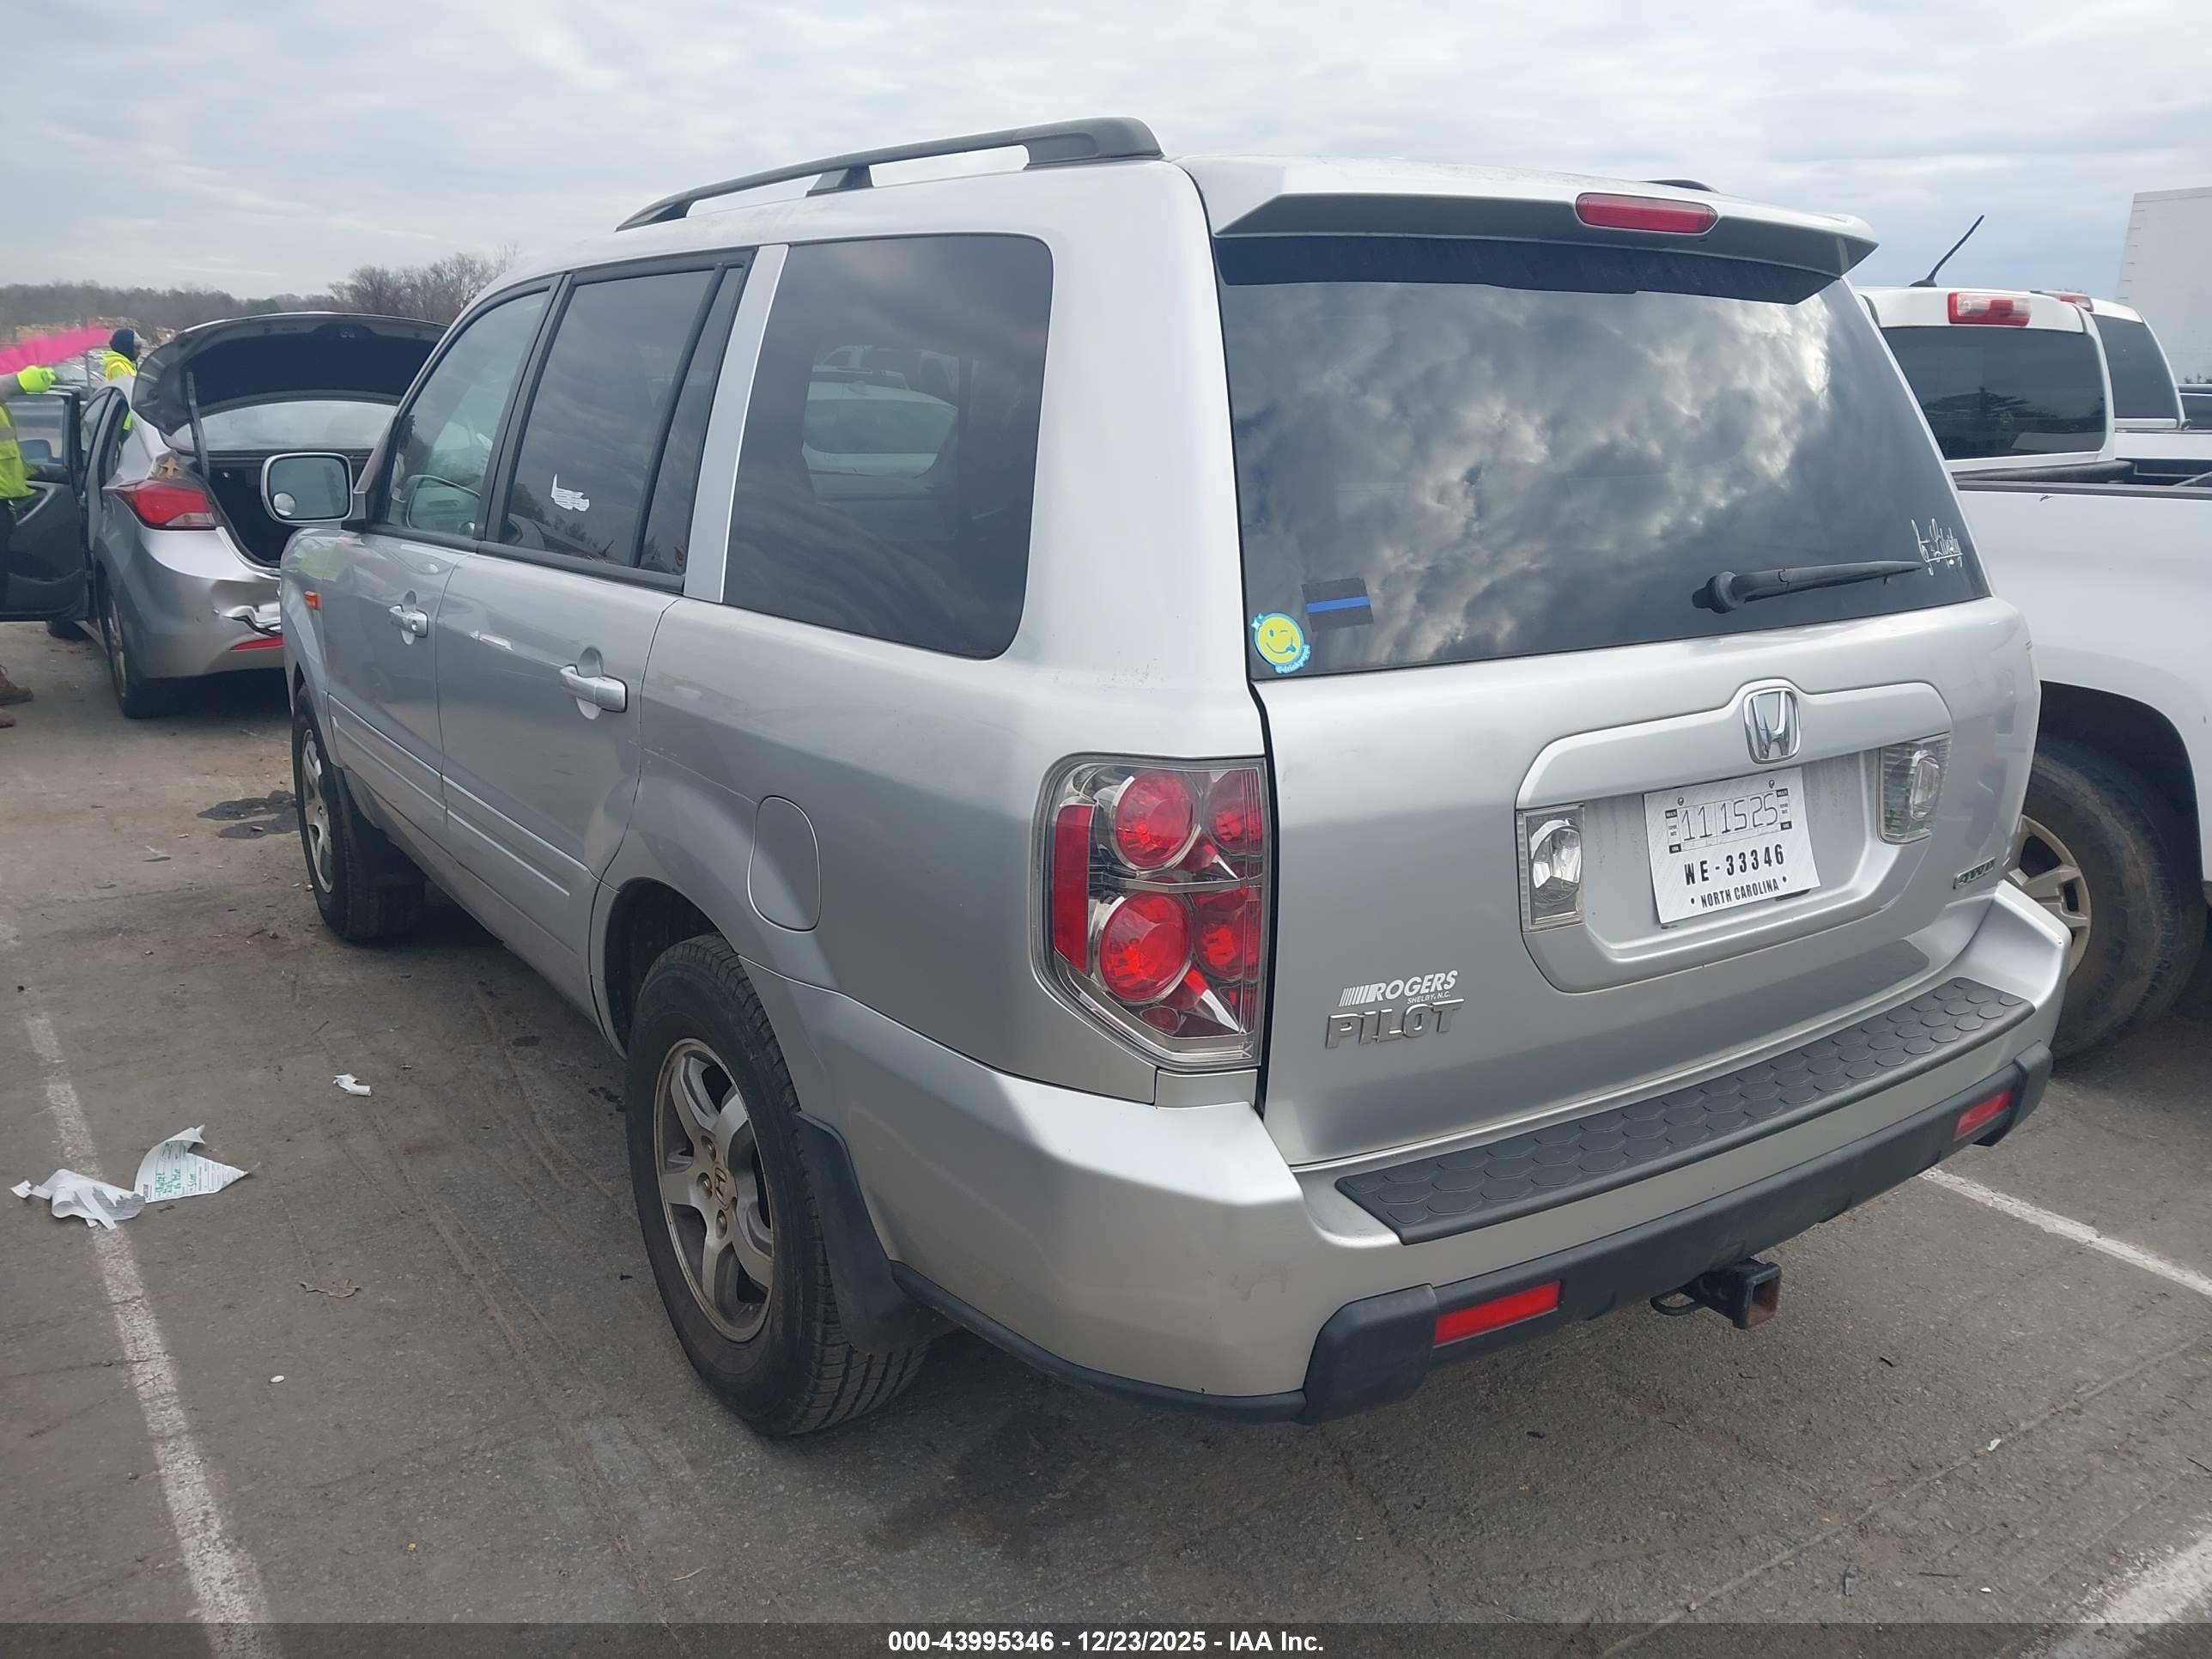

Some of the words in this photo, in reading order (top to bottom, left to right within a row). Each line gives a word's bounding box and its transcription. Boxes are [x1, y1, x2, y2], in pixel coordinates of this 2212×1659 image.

[1684, 844, 1784, 885] WE-33346
[1700, 888, 1732, 908] NORTH
[1734, 878, 1780, 900] CAROLINA
[1362, 969, 1459, 1003] ROGERS
[1325, 998, 1464, 1050] PILOT
